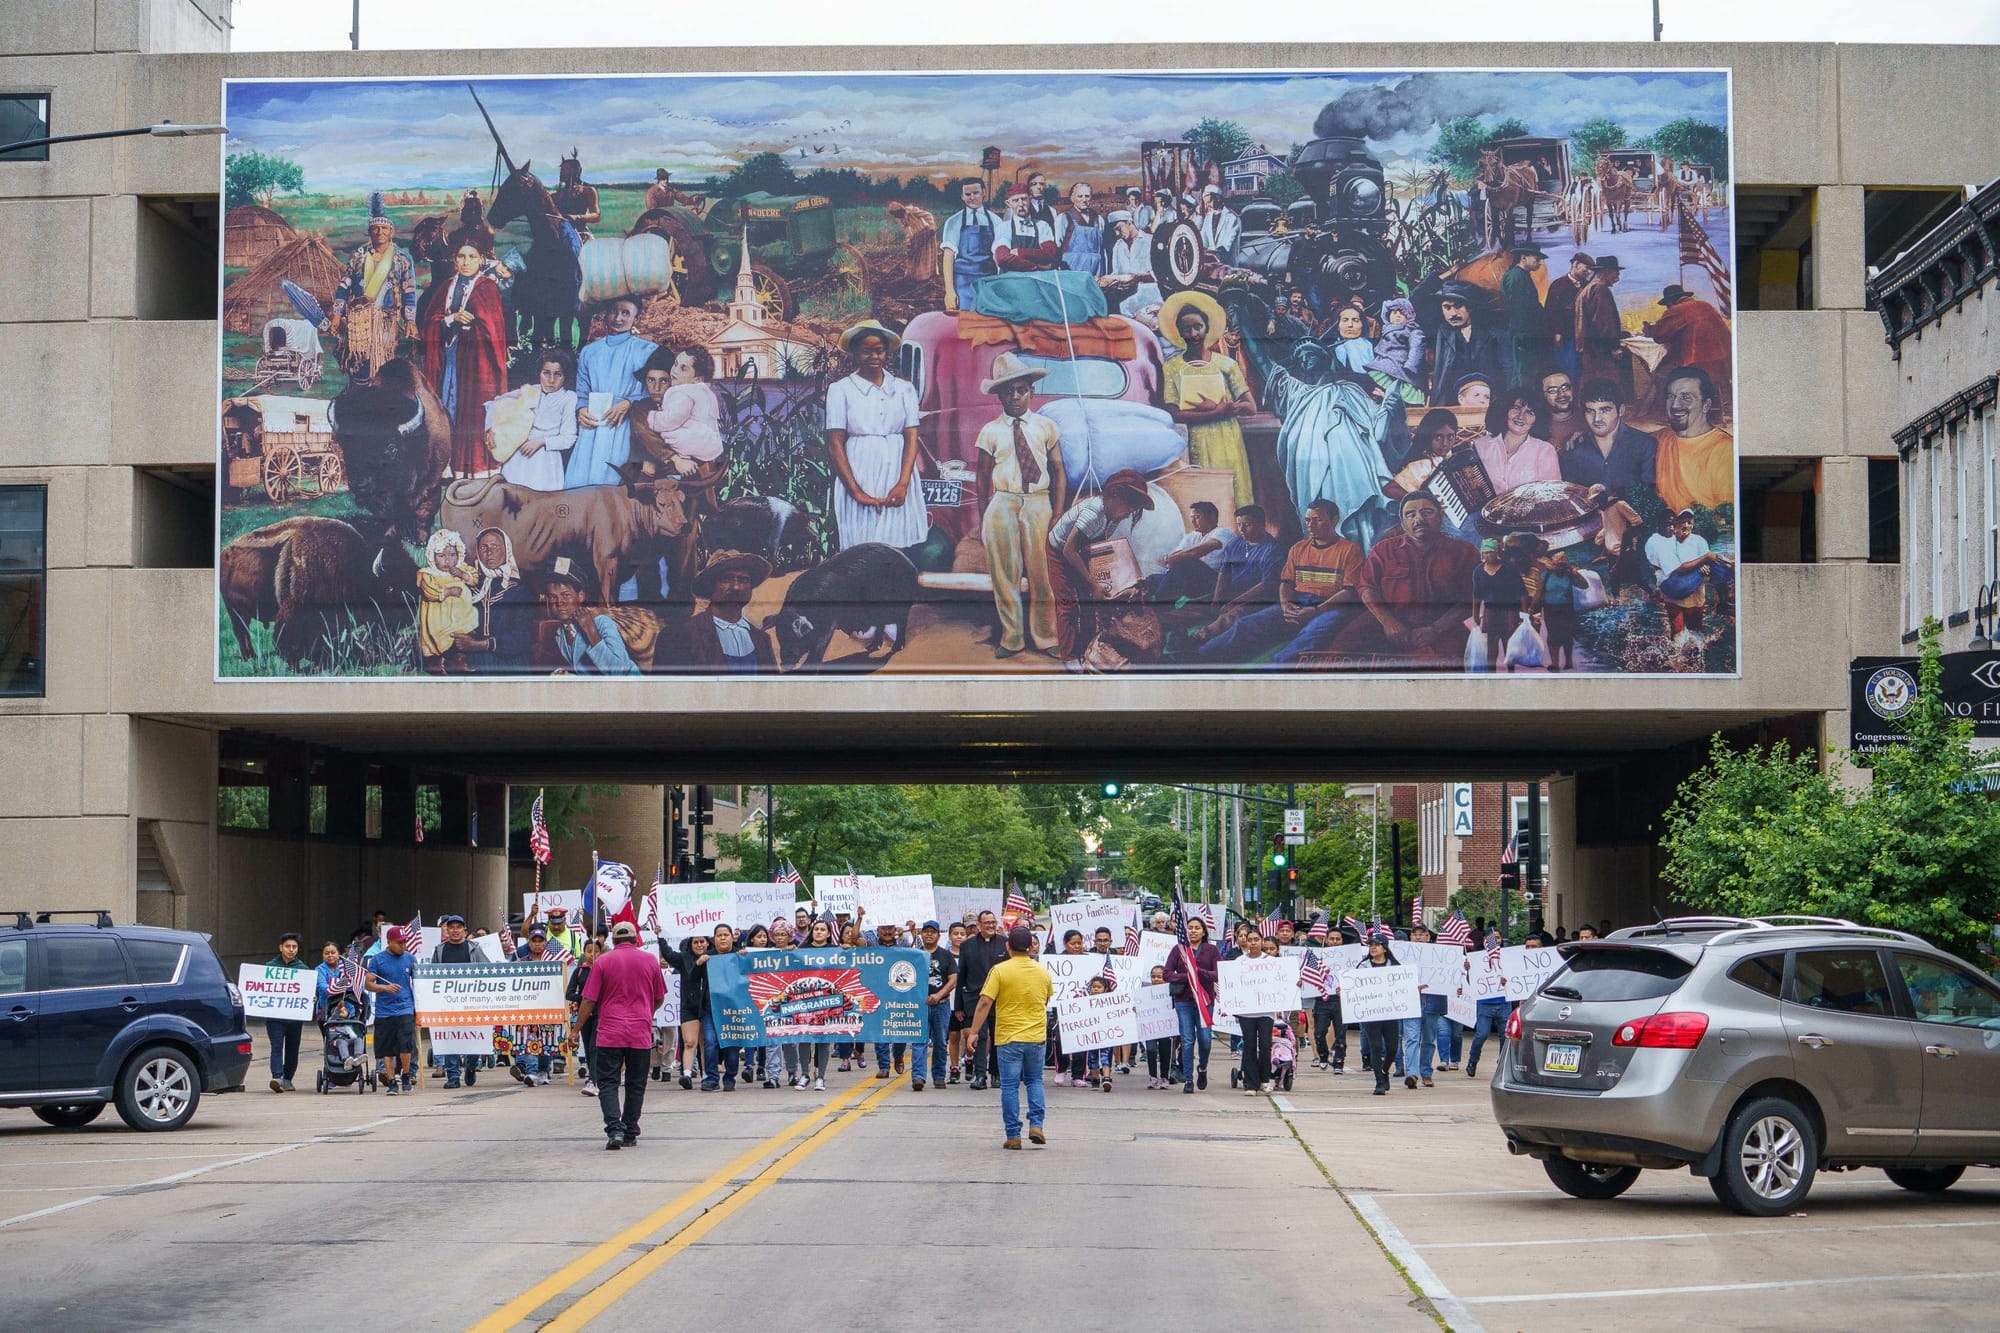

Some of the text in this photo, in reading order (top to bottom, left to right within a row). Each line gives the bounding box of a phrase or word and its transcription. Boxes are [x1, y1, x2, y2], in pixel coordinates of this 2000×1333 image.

[1943, 701, 1972, 716] NO
[541, 895, 562, 906] NO
[665, 890, 690, 908] Keep
[675, 908, 724, 930] Together
[1055, 909, 1083, 926] Keep
[753, 955, 781, 970] July
[829, 954, 847, 966] de
[851, 952, 885, 967] julio
[1431, 951, 1457, 964] NO
[1523, 952, 1551, 970] NO
[264, 967, 298, 980] KEEP
[1047, 960, 1073, 977] NO
[245, 981, 301, 994] FAMILIES
[432, 978, 550, 994] E Pluribus Unum
[247, 995, 309, 1010] TOGETHER
[781, 997, 841, 1014] INMIGRANTES
[1060, 993, 1131, 1016] LAS FAMILIAS
[722, 1007, 752, 1016] March
[731, 1015, 746, 1023] for
[890, 1011, 905, 1019] por
[722, 1024, 756, 1032] Human
[883, 1019, 922, 1028] Dignidad
[1061, 1017, 1100, 1033] MERECEN
[434, 1031, 485, 1041] HUMANA
[720, 1031, 759, 1041] Dignity!
[1076, 1026, 1125, 1047] UNIDOS
